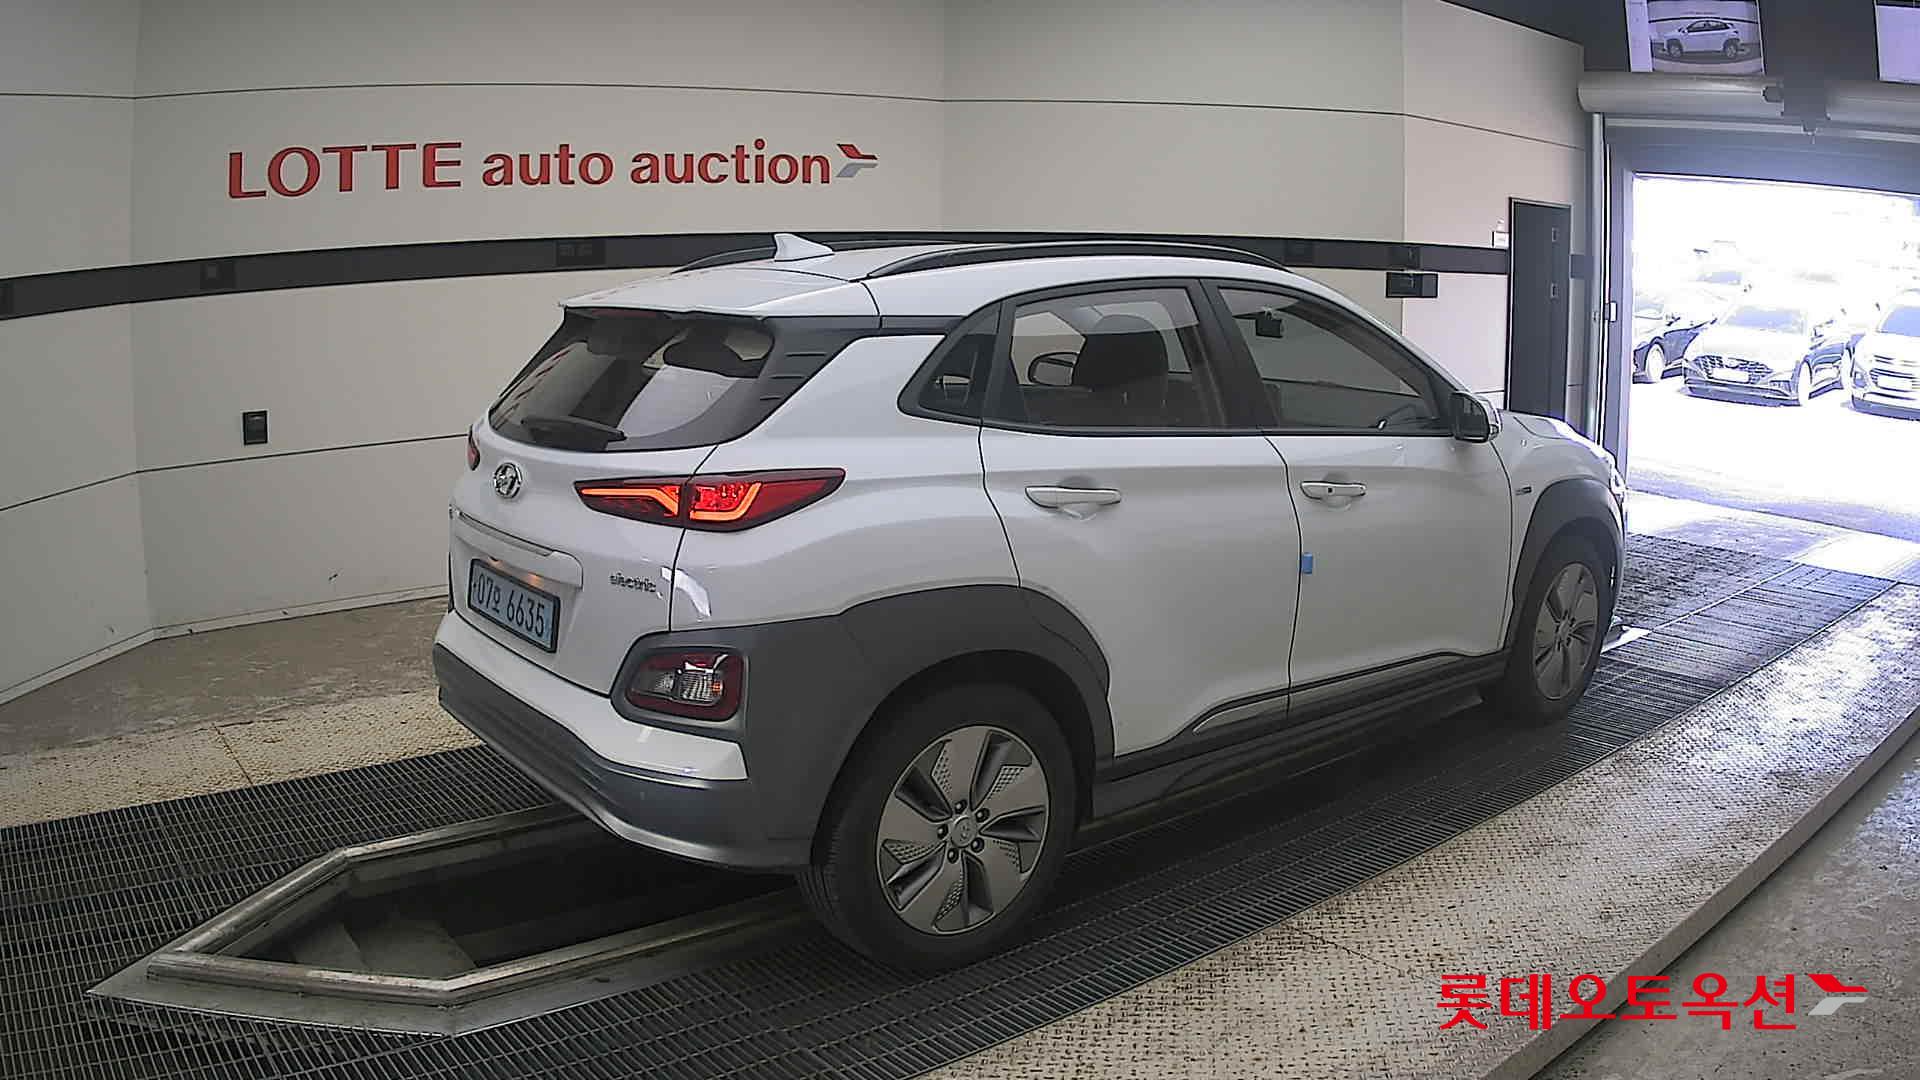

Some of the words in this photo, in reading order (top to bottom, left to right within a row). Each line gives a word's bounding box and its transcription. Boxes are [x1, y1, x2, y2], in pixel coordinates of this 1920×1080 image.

[228, 142, 463, 199] LOTTE
[481, 143, 614, 186] auto
[630, 140, 831, 185] auction
[609, 572, 657, 593] electric
[506, 589, 544, 637] 6635
